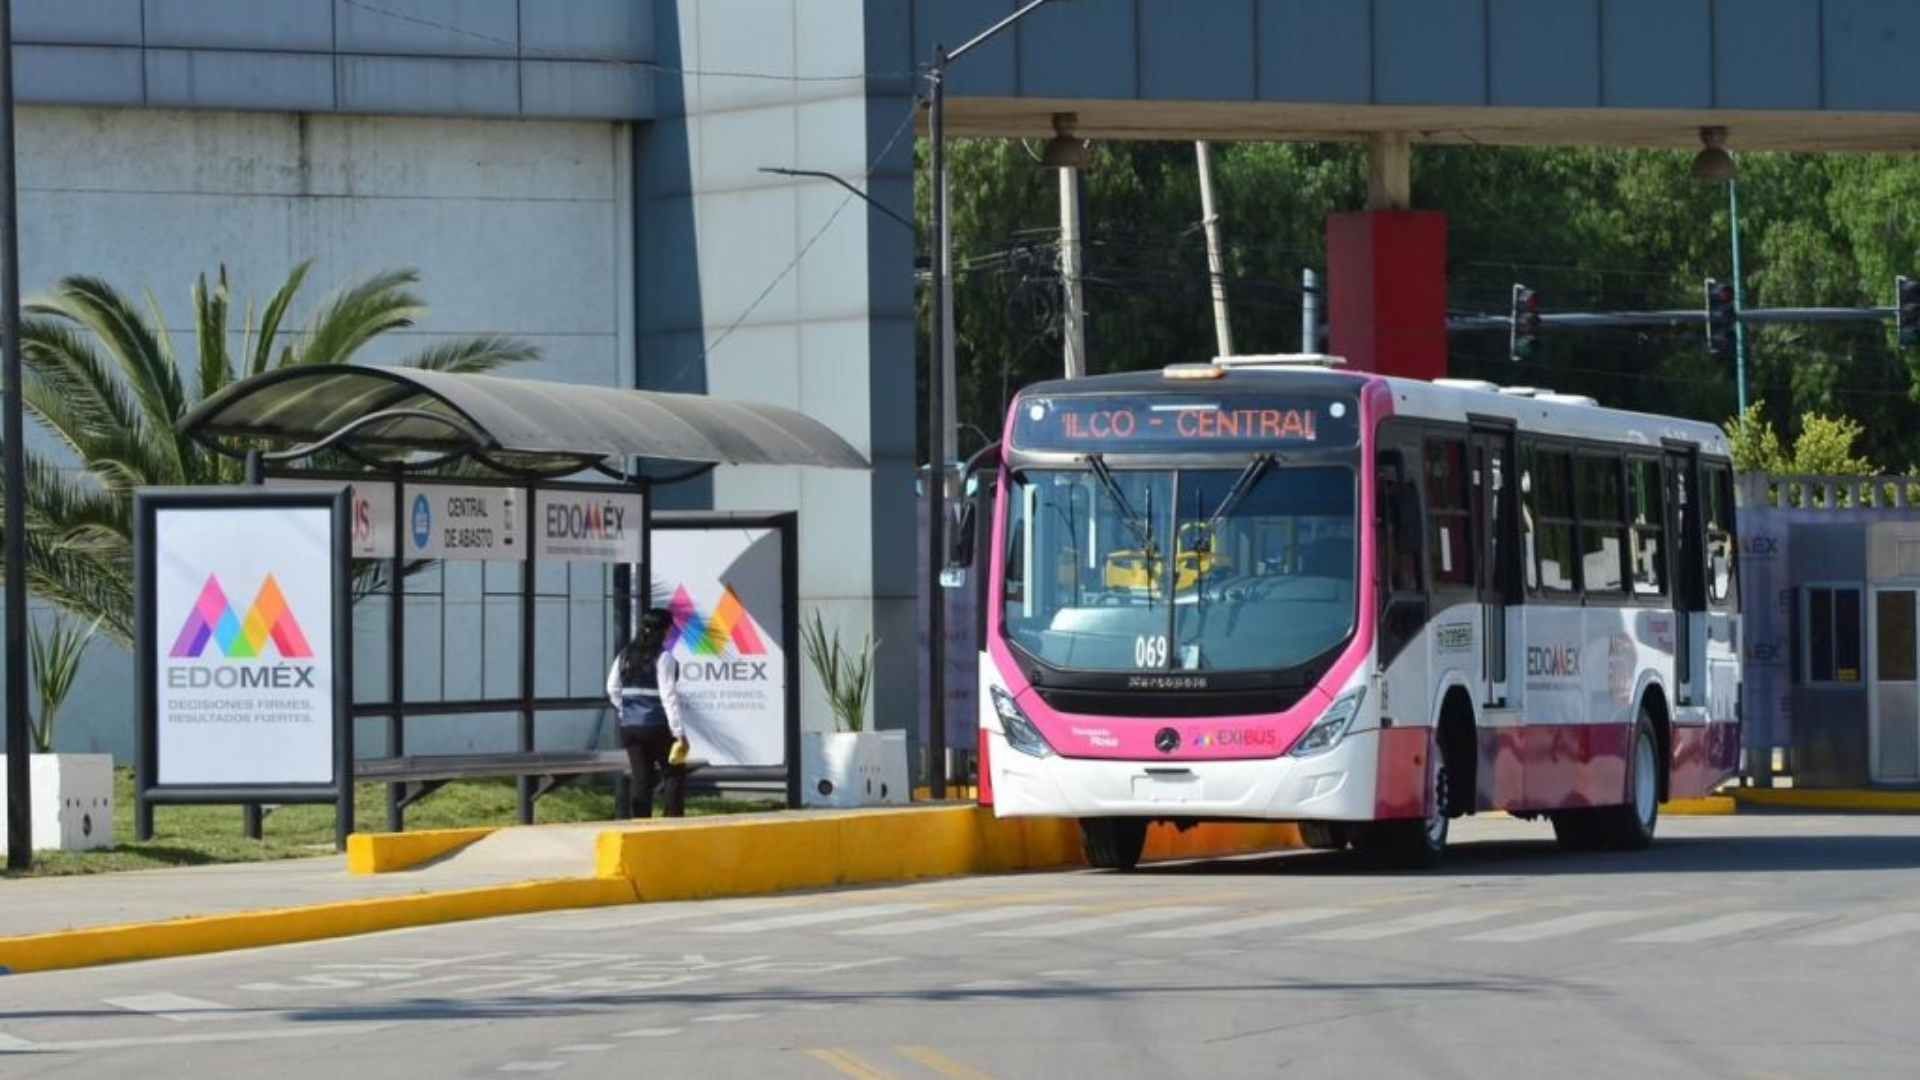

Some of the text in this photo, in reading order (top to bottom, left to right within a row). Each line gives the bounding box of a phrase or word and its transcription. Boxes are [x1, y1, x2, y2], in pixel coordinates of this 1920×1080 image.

[1177, 410, 1316, 439] CENTRAL
[448, 497, 488, 518] CENTRAL
[444, 528, 494, 548] DE ABASTO
[1135, 633, 1167, 668] 069
[167, 661, 315, 689] EDOMÉX
